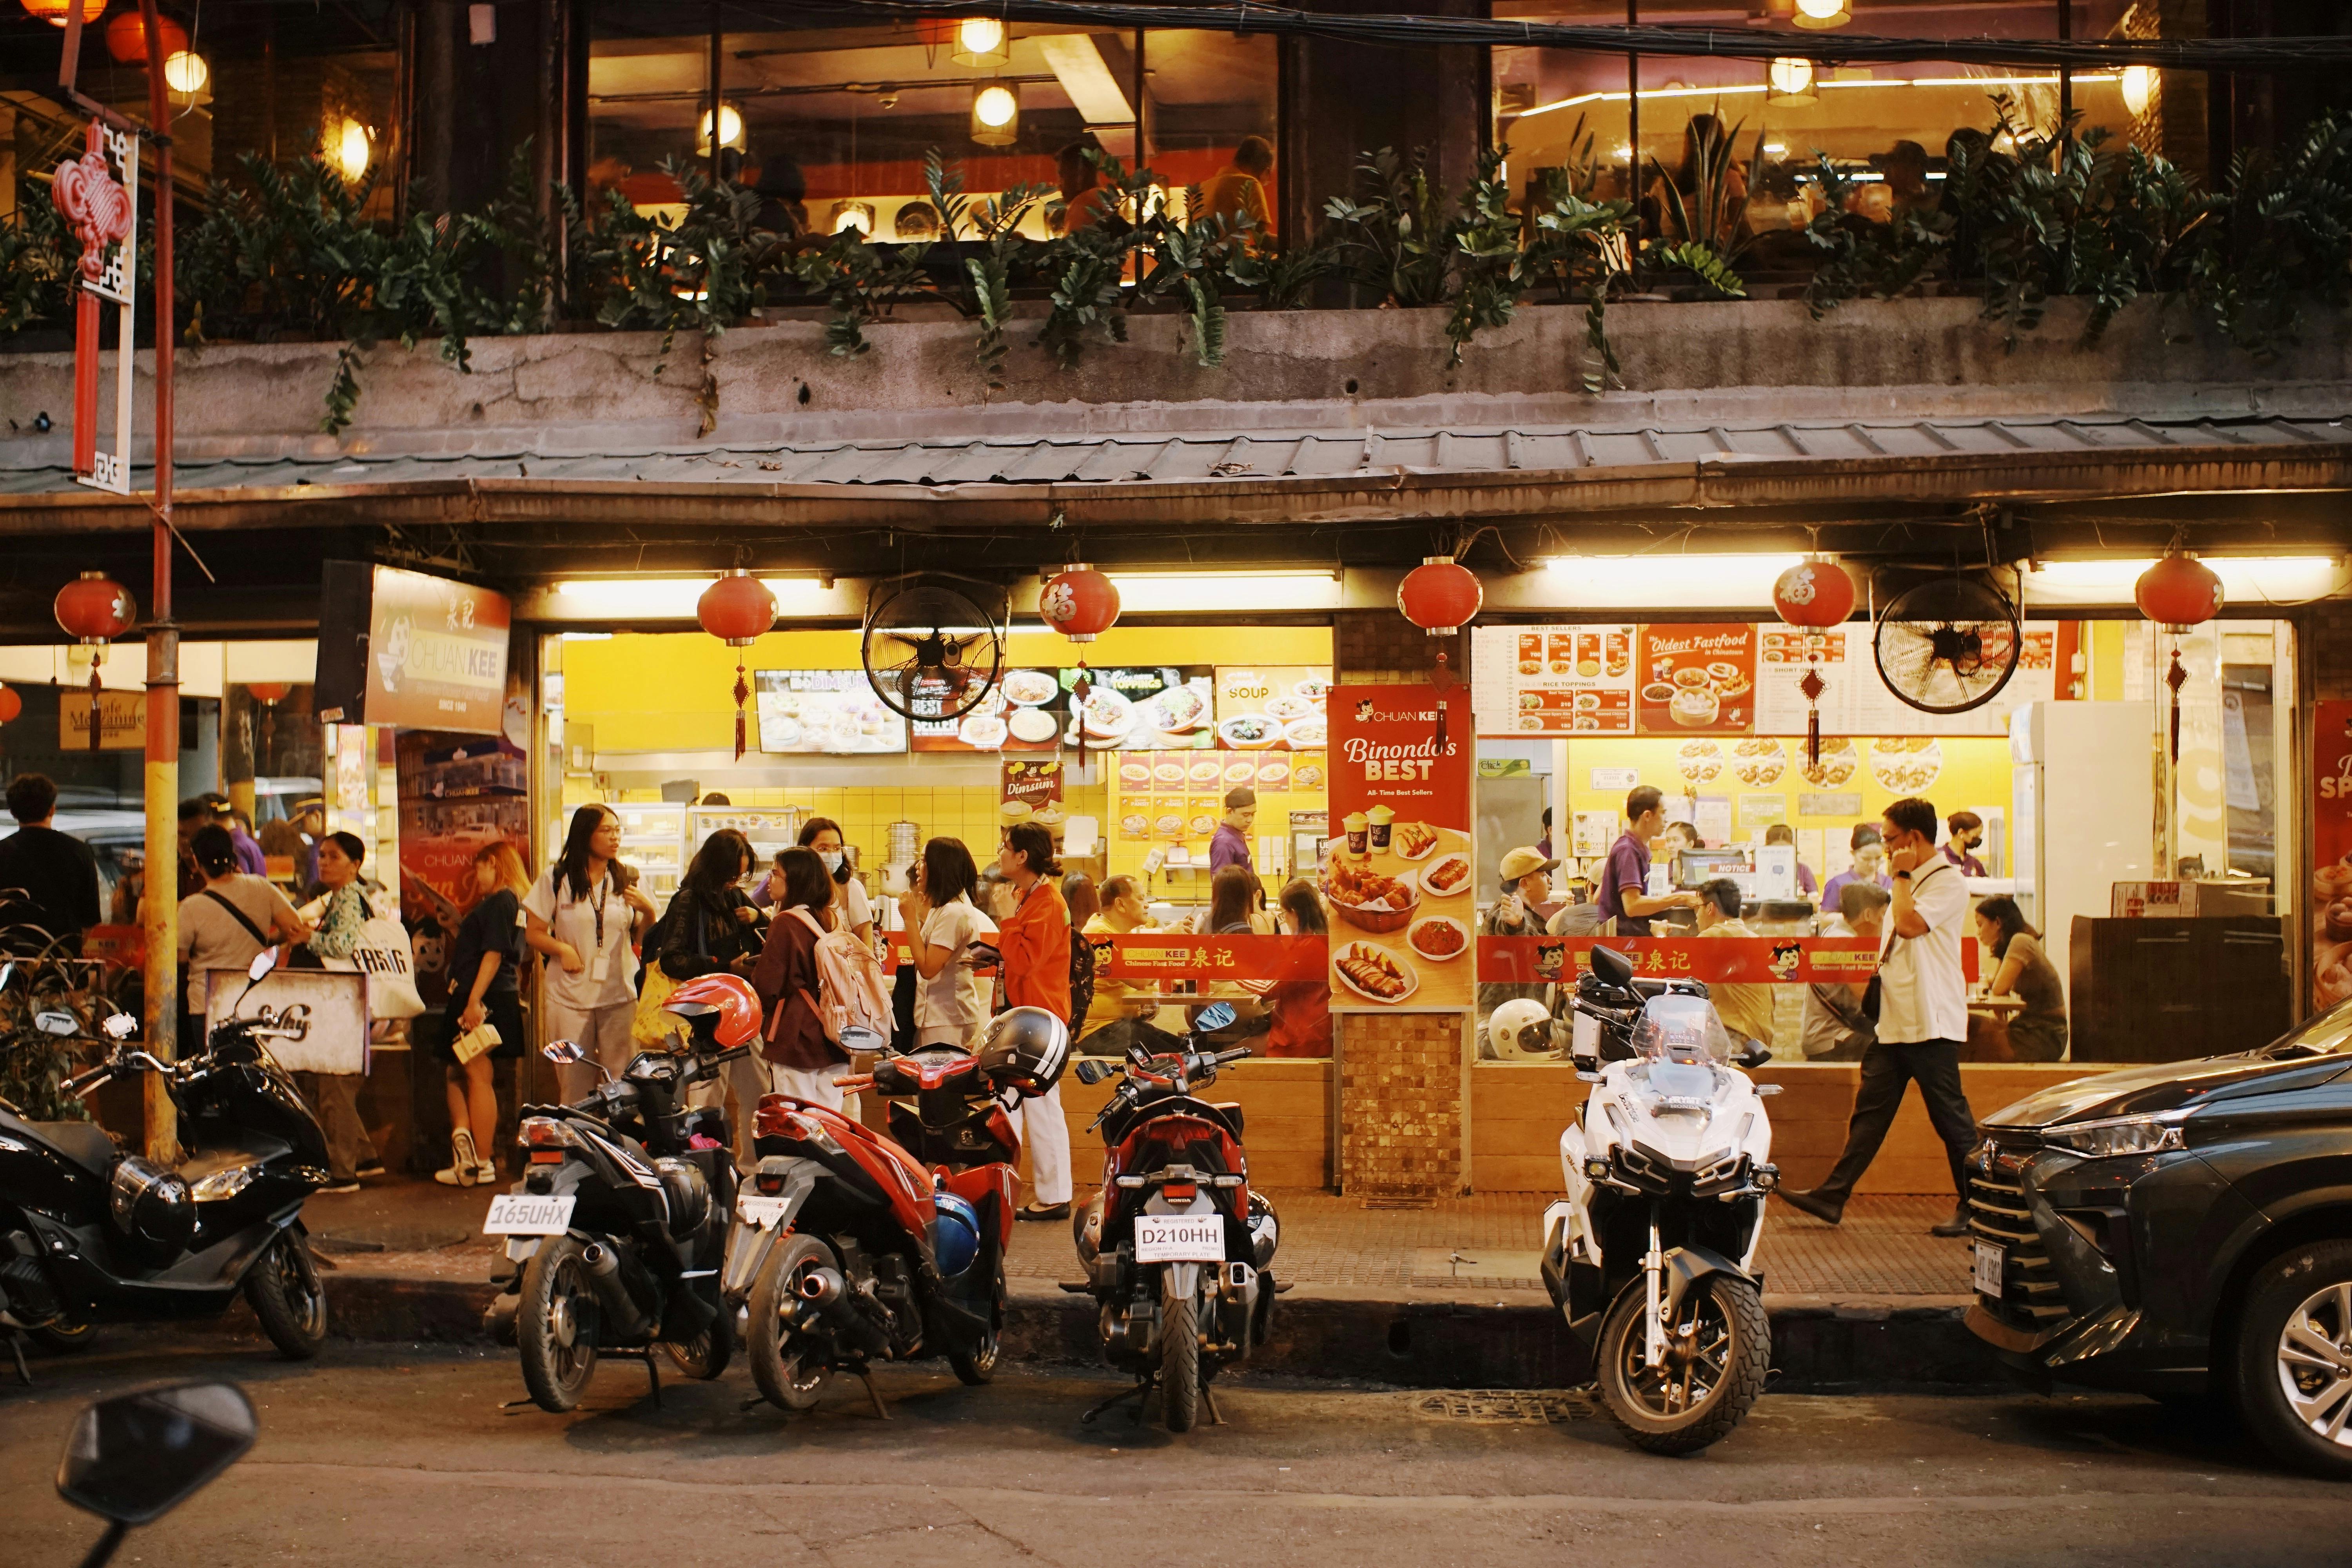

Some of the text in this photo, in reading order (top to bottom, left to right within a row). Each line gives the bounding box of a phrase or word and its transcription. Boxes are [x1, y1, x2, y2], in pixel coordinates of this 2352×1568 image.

[1651, 637, 1691, 652] Oldest
[1693, 631, 1748, 648] Fastfood
[412, 637, 497, 679] CHUAN KEE
[811, 676, 870, 690] DIMSUM
[1112, 669, 1133, 682] Rice
[1112, 679, 1162, 690] TOPPINGS
[1229, 687, 1269, 699] SOUP
[1374, 711, 1417, 722] CHUAN
[913, 717, 959, 732] SELLER
[1343, 735, 1457, 763] Binondo's
[1365, 759, 1434, 781] BEST
[1007, 780, 1056, 795] Dimsum
[424, 854, 474, 868] CHUAN
[1718, 864, 1751, 873] NOTICE
[1127, 950, 1163, 958] CHUAN
[1191, 946, 1235, 968] 泉记
[1645, 949, 1691, 972] 泉记
[1815, 953, 1875, 962] CHUAN KEE
[491, 1203, 568, 1225] 165UHX
[1142, 1227, 1217, 1244] D210HH
